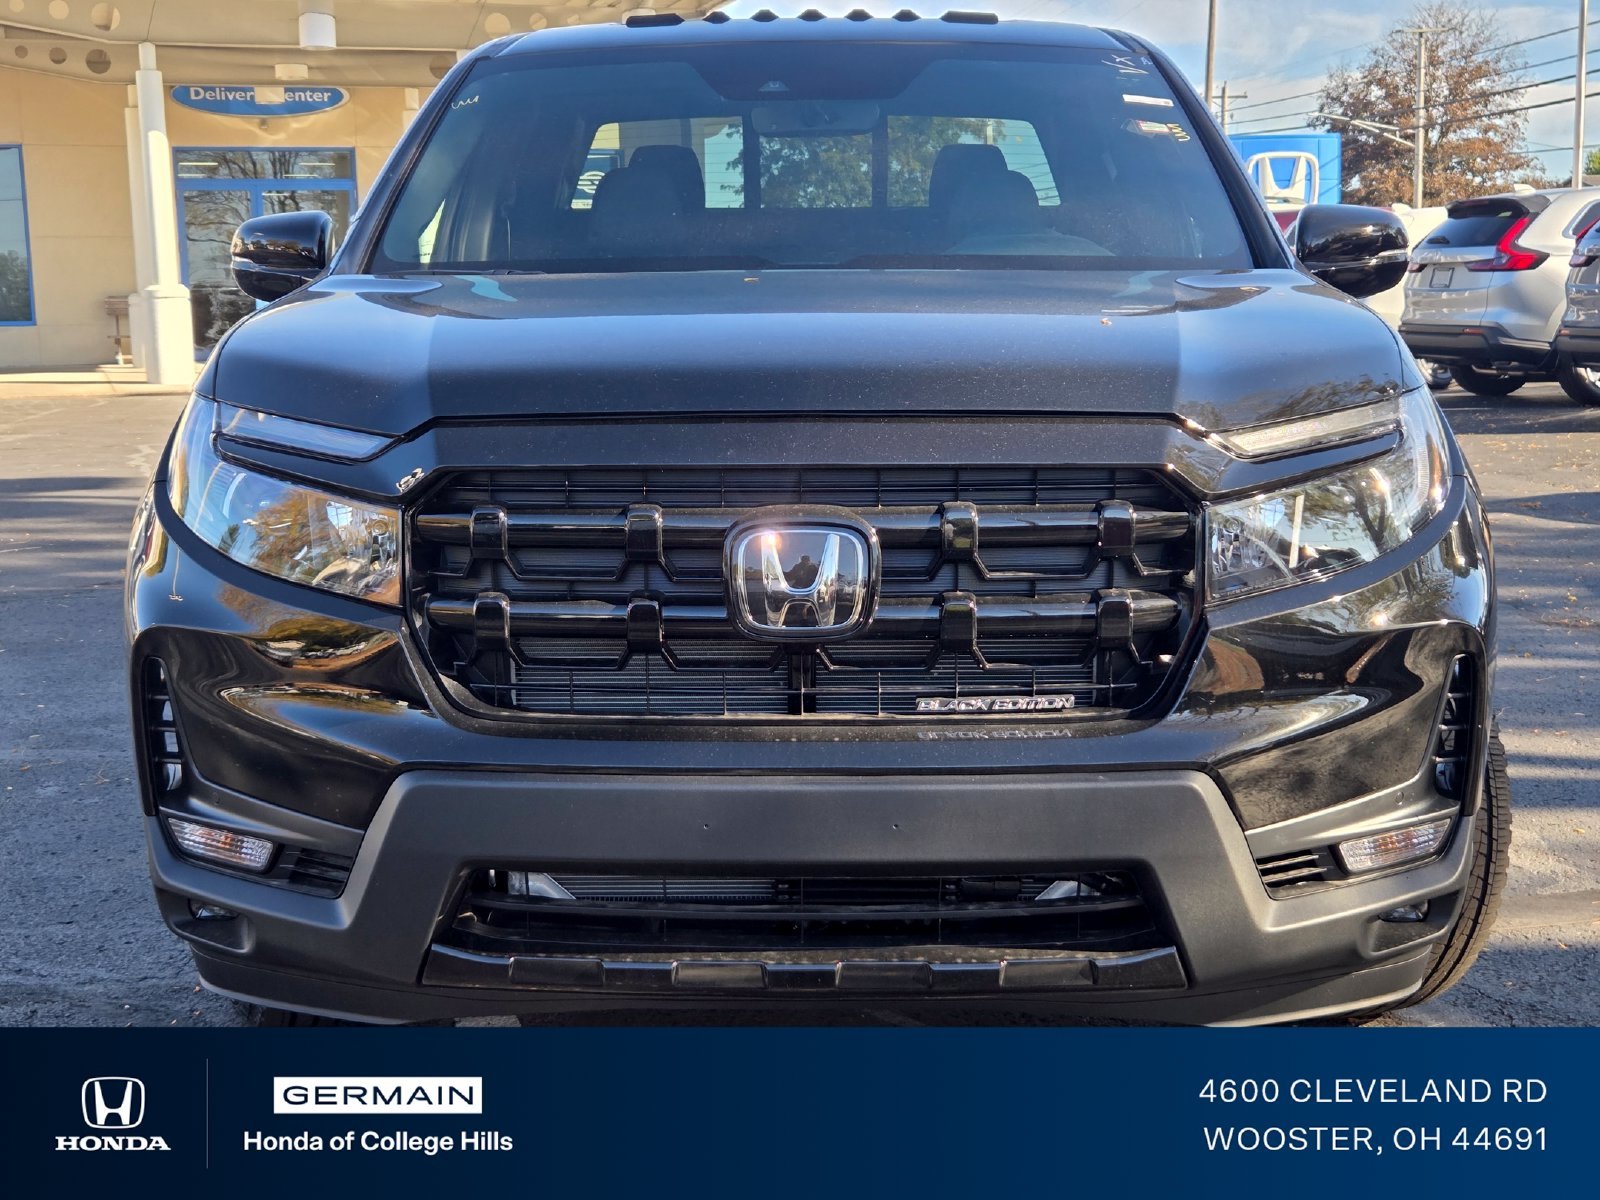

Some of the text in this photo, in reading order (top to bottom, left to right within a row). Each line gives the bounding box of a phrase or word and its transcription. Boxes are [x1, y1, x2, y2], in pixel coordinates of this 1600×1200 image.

[189, 87, 332, 102] Deliver enter
[916, 695, 1074, 711] BLACK EDITION
